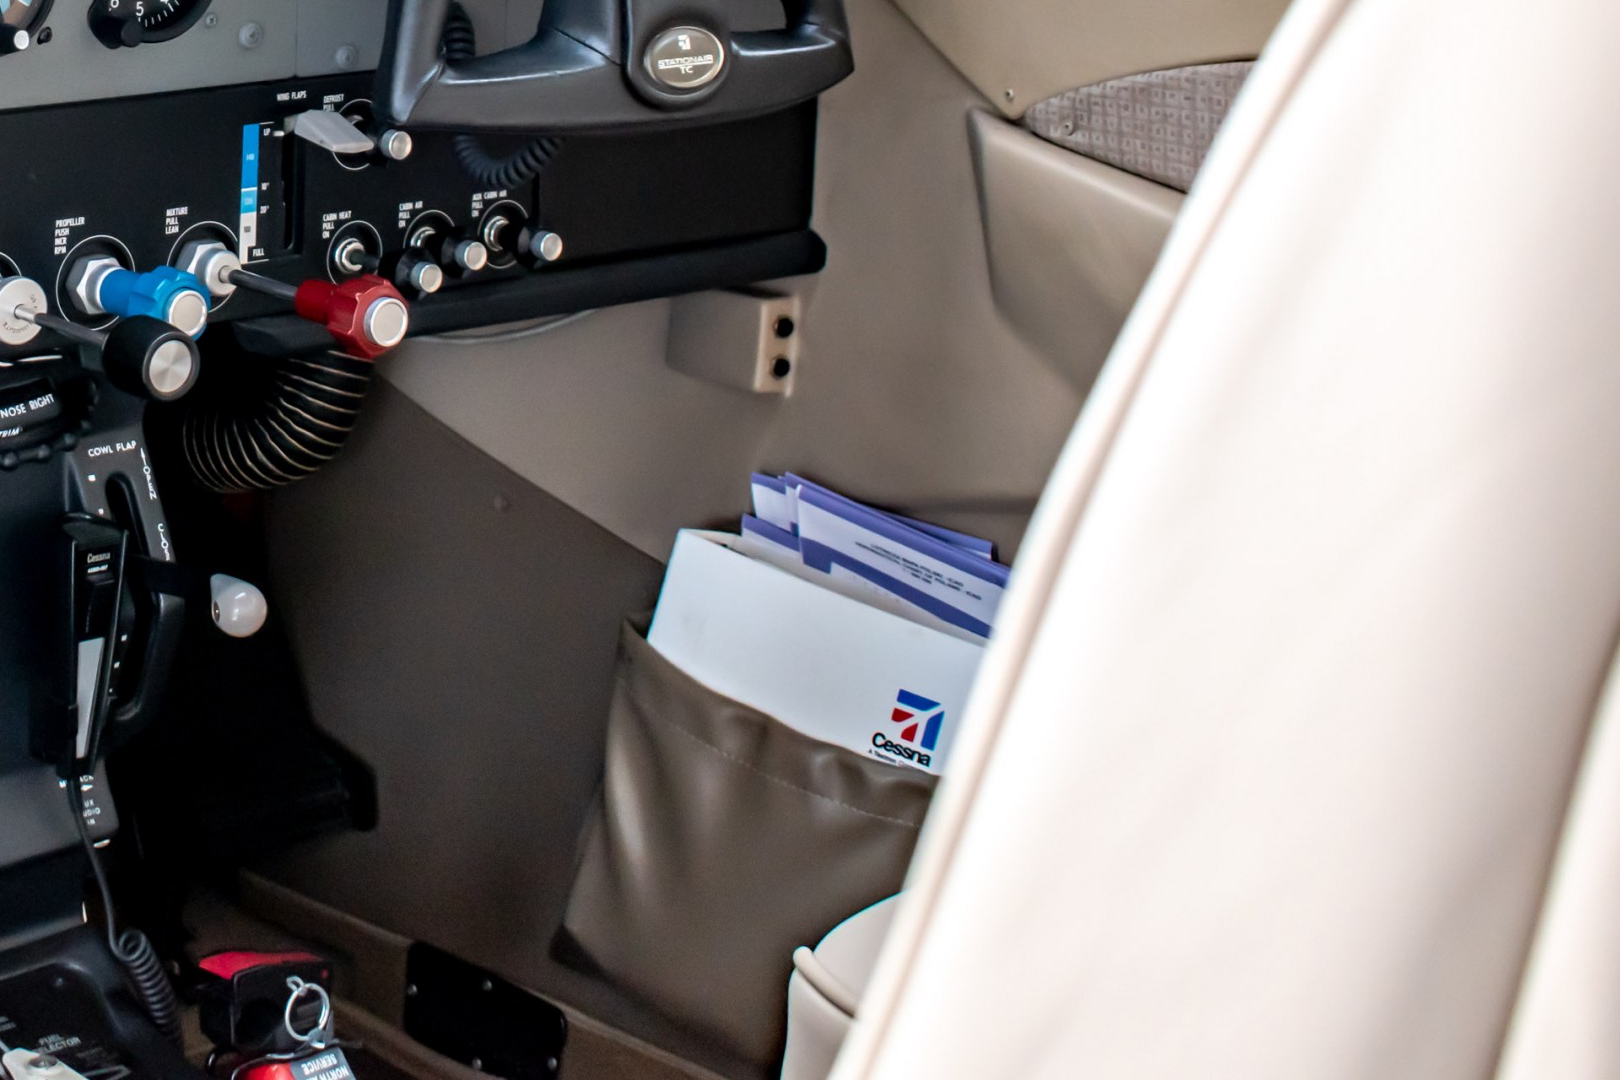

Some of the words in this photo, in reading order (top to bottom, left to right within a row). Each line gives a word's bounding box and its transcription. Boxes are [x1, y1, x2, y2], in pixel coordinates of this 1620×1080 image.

[135, 1, 144, 17] 5
[658, 54, 713, 67] STATIONAIR
[680, 65, 694, 74] TC
[276, 91, 289, 101] WING
[291, 90, 307, 101] FLAPS
[323, 94, 344, 104] DEFROST
[472, 192, 482, 201] AUX
[483, 191, 498, 201] CABIN
[498, 189, 507, 198] AIR
[166, 205, 188, 217] MIXTURE
[399, 202, 413, 211] CABIN
[414, 200, 423, 210] AIR
[339, 210, 352, 220] HEAT
[55, 216, 85, 227] PROPELLER
[55, 226, 70, 237] PUSH
[165, 225, 179, 235] LEAN
[54, 245, 67, 255] RPM
[252, 248, 265, 257] FULL
[0, 403, 27, 420] NOSE
[28, 393, 55, 412] RIGHT
[88, 445, 113, 457] COWL
[116, 440, 137, 452] FLAP
[143, 465, 158, 500] OPEN
[871, 732, 932, 767] Cessna
[38, 1033, 62, 1046] FUEL
[301, 1053, 338, 1076] SERVICE
